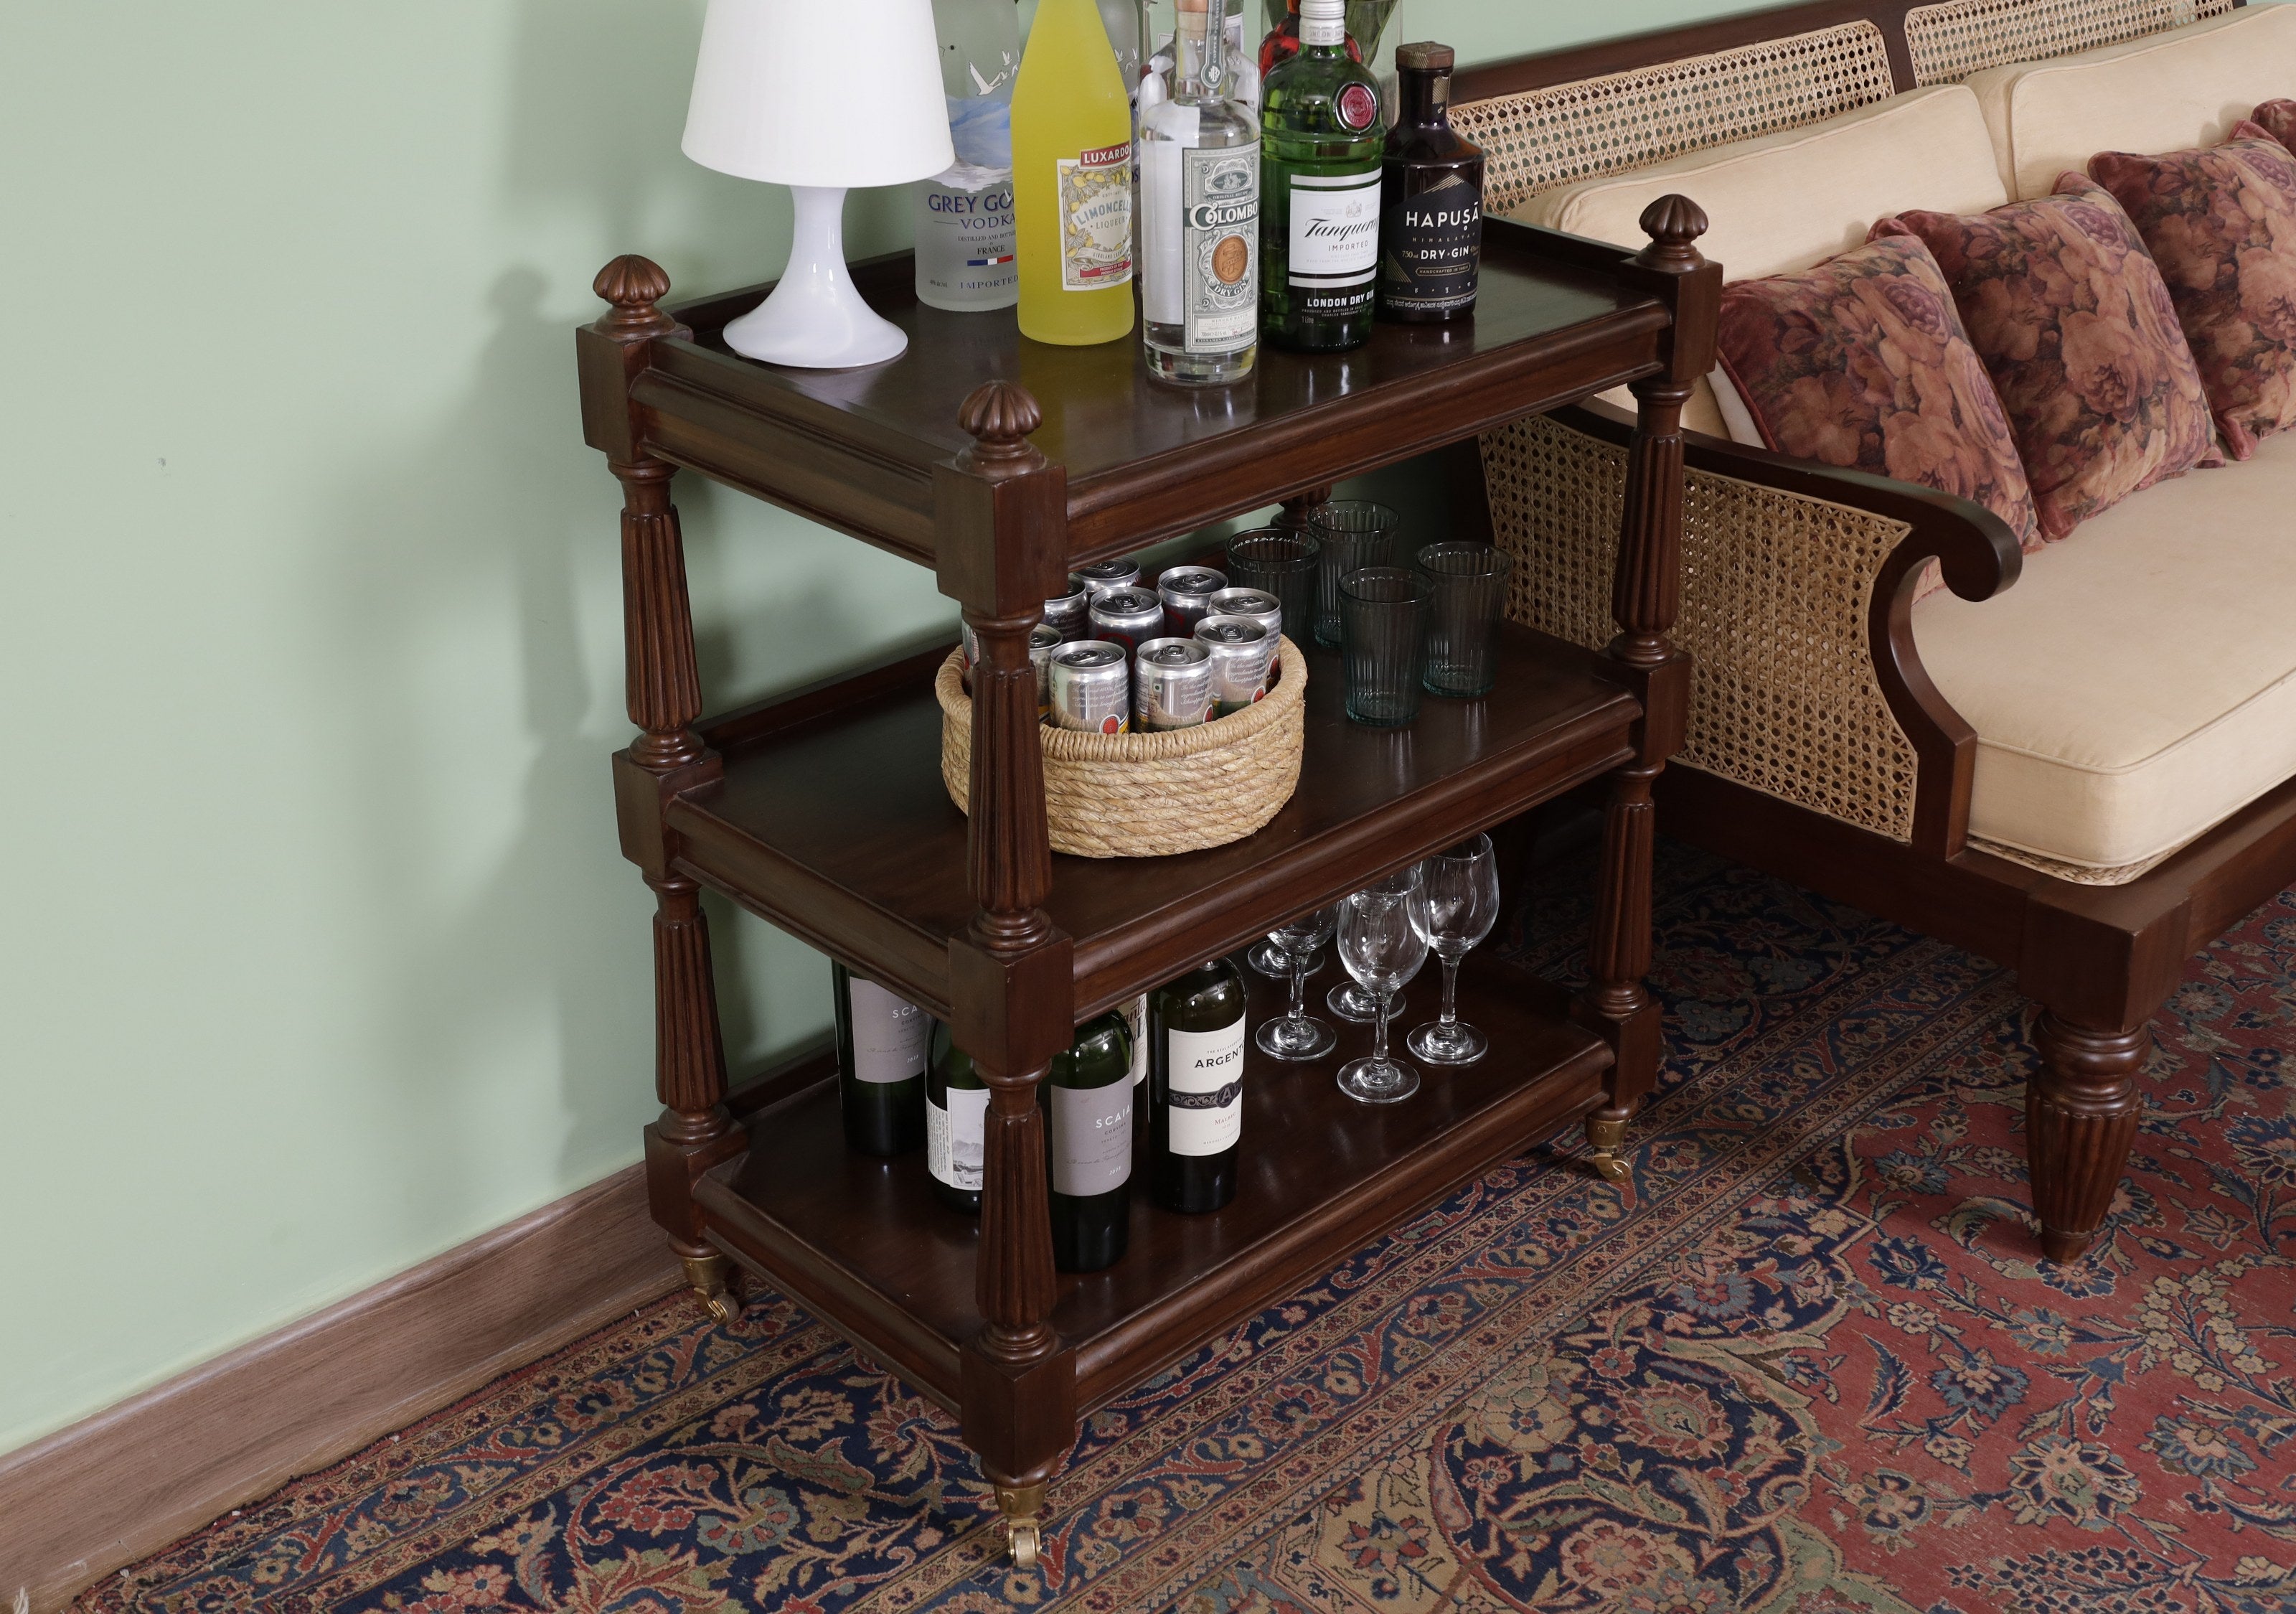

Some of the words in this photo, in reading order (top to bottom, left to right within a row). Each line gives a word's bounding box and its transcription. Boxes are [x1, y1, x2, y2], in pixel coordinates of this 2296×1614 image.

[1083, 144, 1129, 164] LUXARDO
[928, 194, 978, 214] GREY
[959, 213, 1015, 230] VODKA
[1096, 215, 1126, 230] LIQUEUR
[1189, 201, 1258, 231] COLOMBO
[977, 245, 1005, 255] FRANCE
[1328, 240, 1368, 252] IMPORTED
[1421, 249, 1446, 260] DRY
[1451, 245, 1469, 258] GIN
[960, 274, 1019, 288] IMPORTED
[1214, 285, 1233, 296] DRY
[1234, 281, 1247, 295] GIN
[1307, 297, 1347, 307] LONDON
[1350, 293, 1365, 306] DRY
[1366, 288, 1375, 301] GIN
[892, 1005, 918, 1018] SCA
[1096, 1104, 1131, 1129] SCAIA
[1214, 1112, 1236, 1125] MALBEC
